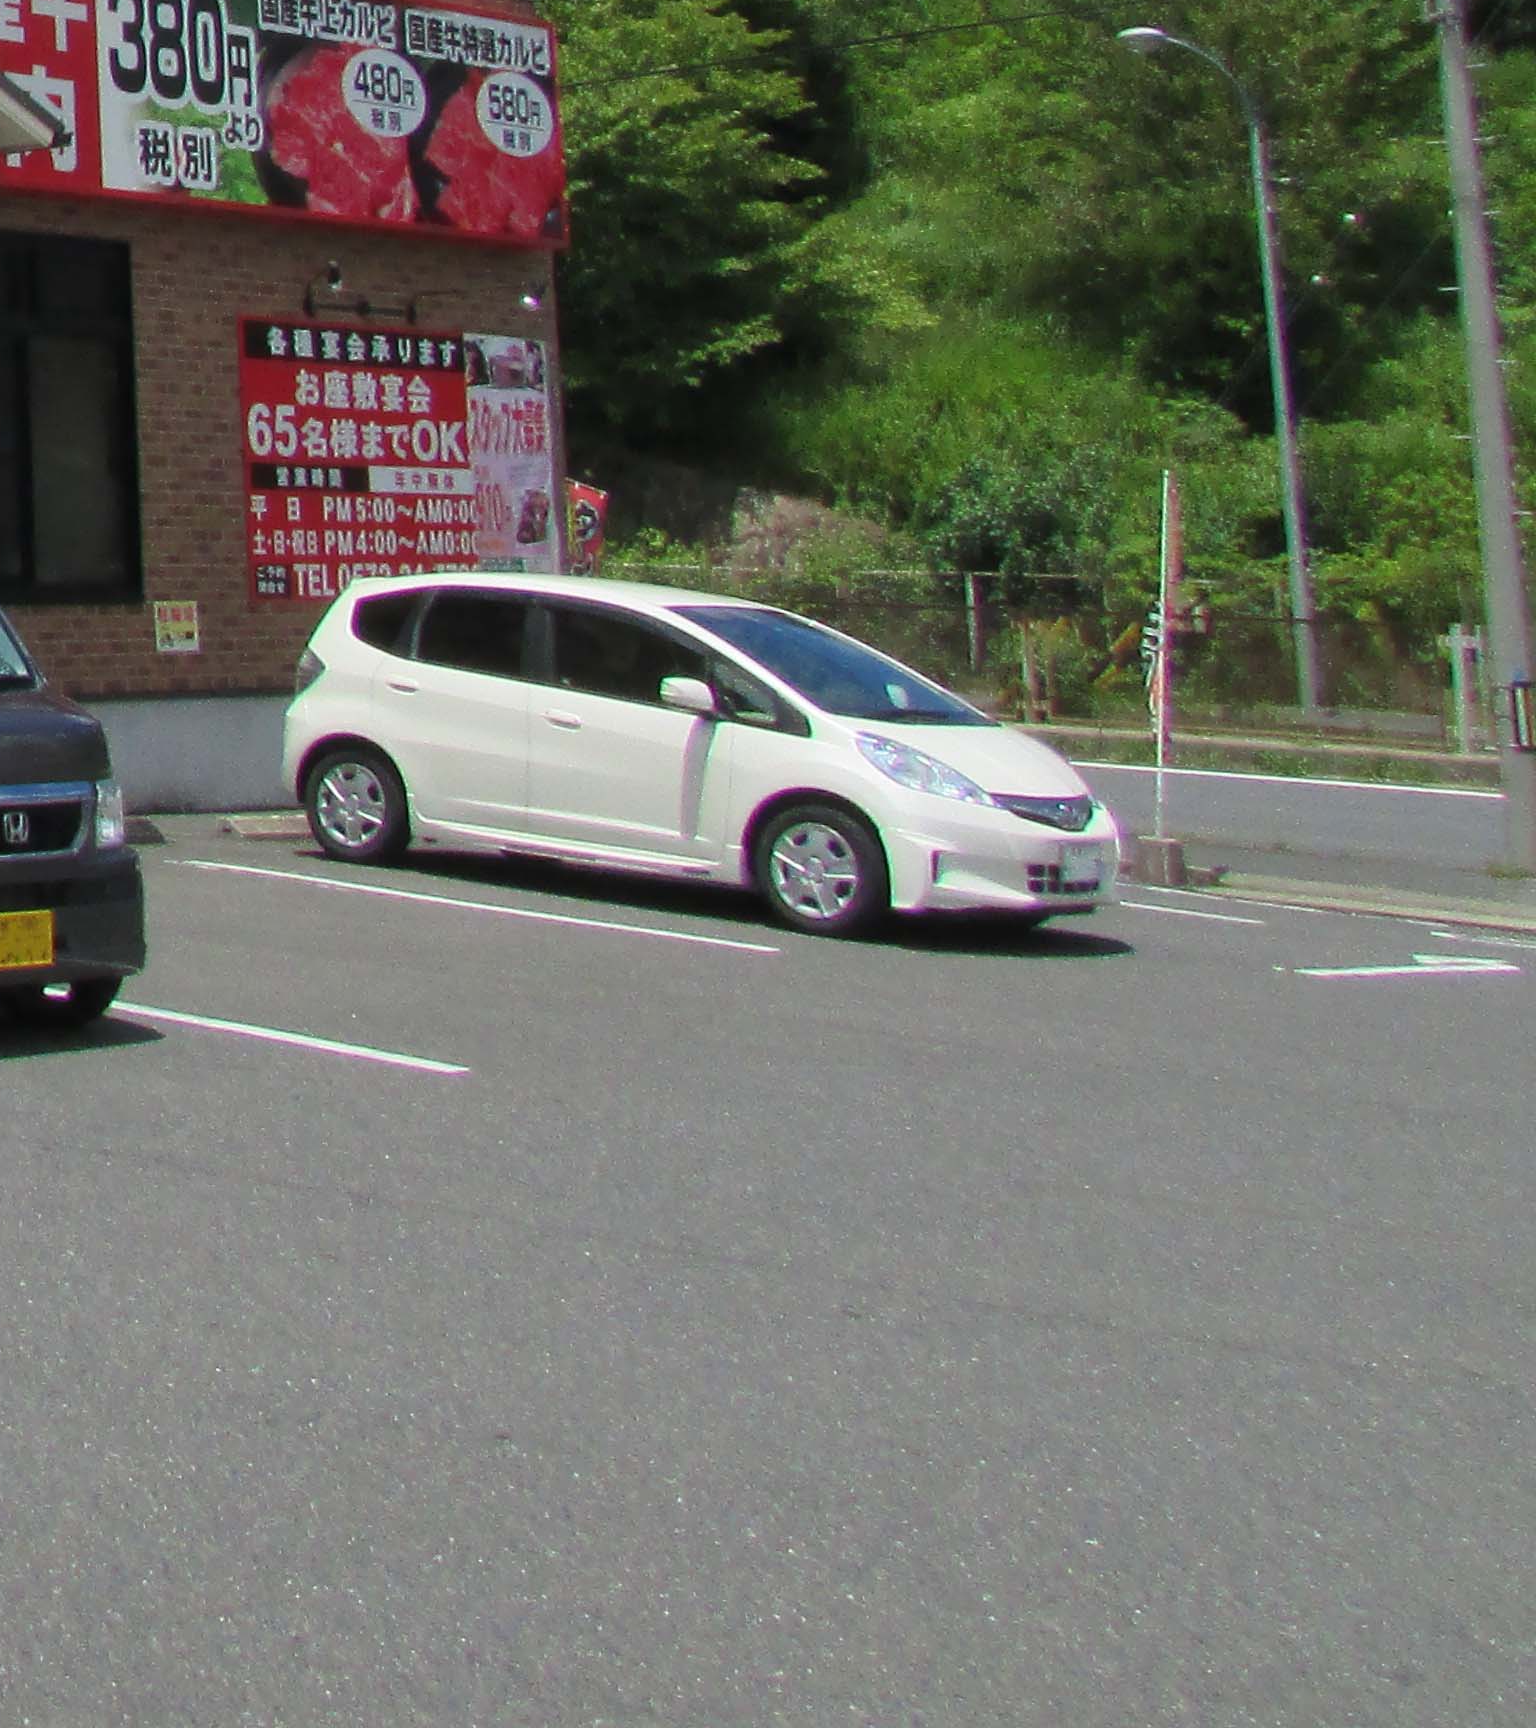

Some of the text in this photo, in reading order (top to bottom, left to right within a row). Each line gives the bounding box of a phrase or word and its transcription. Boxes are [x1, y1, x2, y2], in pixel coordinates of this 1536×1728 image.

[408, 13, 549, 73] 国産牛特選カルビ
[137, 127, 216, 183] 税別
[267, 325, 457, 368] 各種宴会承ります
[294, 368, 432, 414] お座敷宴会
[247, 403, 466, 463] 65名様までOK
[292, 563, 336, 597] TEL
